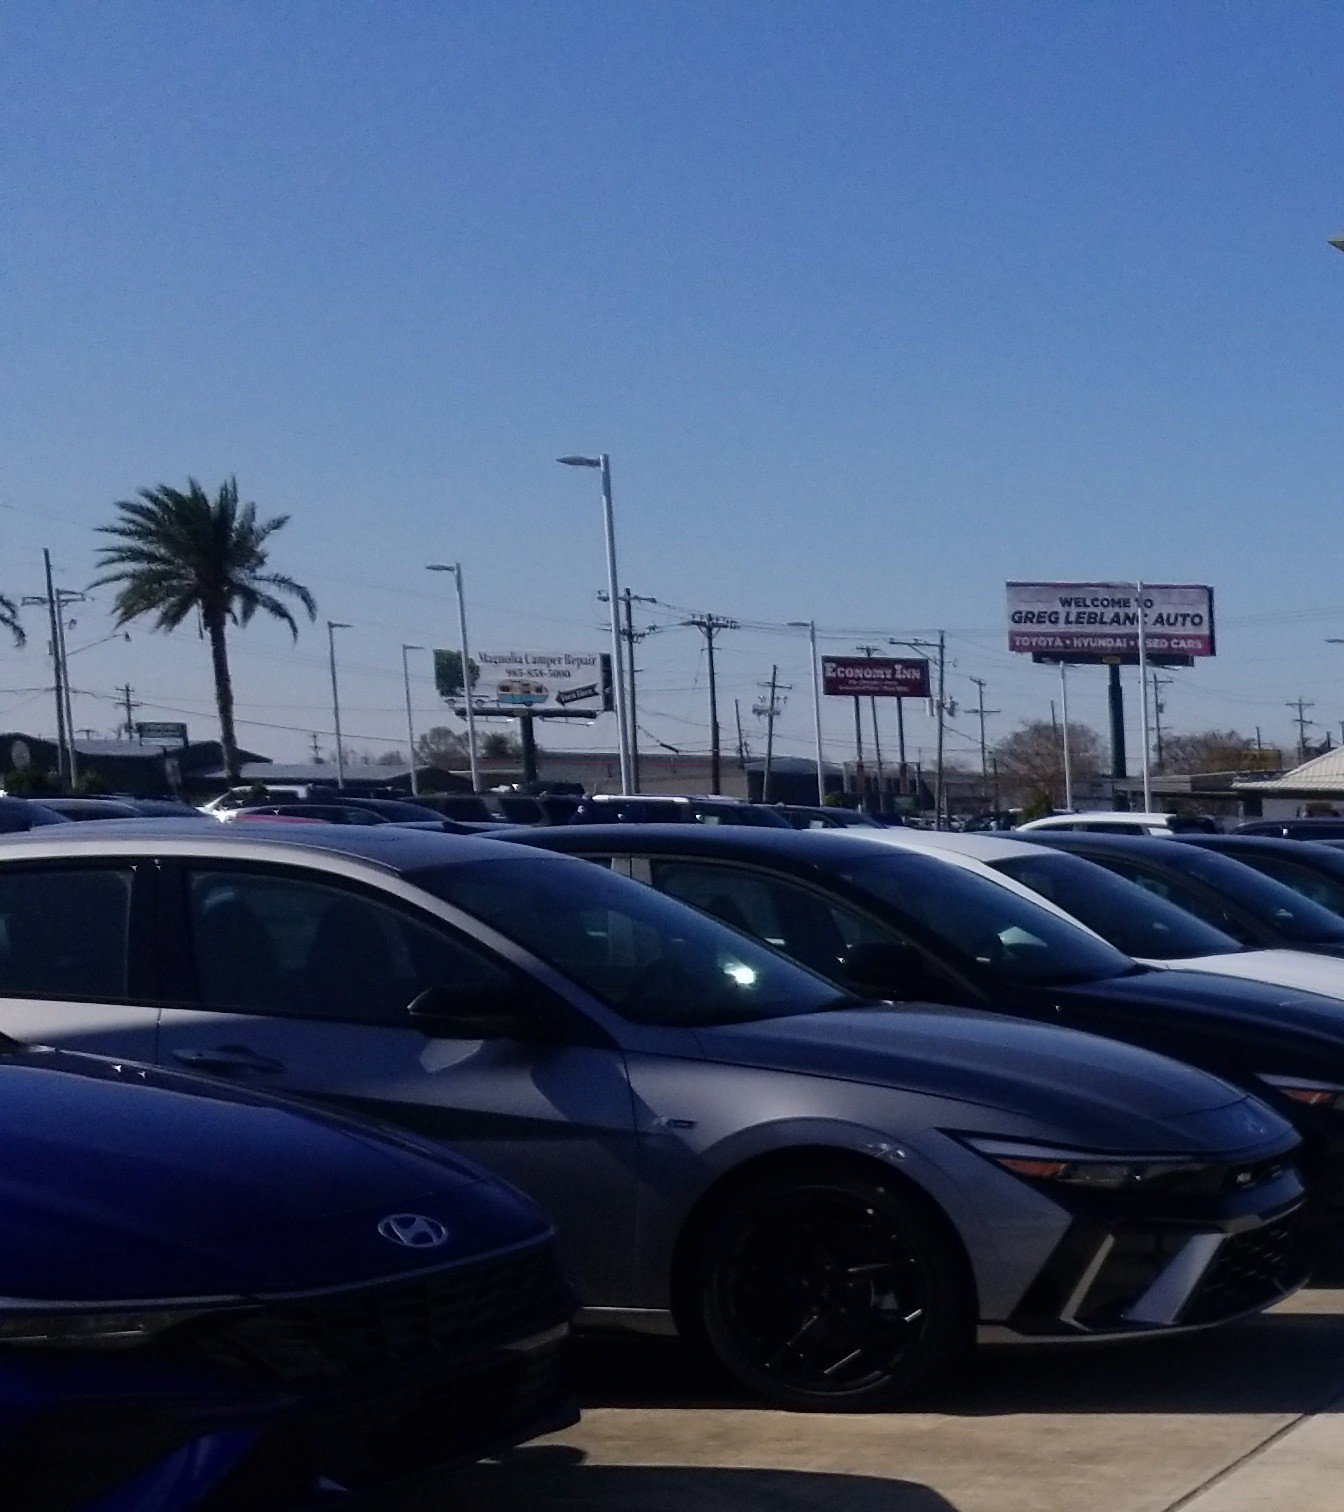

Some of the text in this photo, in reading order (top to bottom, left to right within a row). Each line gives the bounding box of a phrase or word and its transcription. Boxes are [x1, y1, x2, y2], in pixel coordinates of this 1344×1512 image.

[1059, 597, 1131, 608] WELCOME
[1011, 610, 1060, 624] GREG
[1152, 612, 1203, 627] AUTO
[1014, 636, 1202, 649] TOYOTA HYUNDAI SED CARS
[525, 653, 562, 667] Camper
[564, 654, 597, 668] Repair
